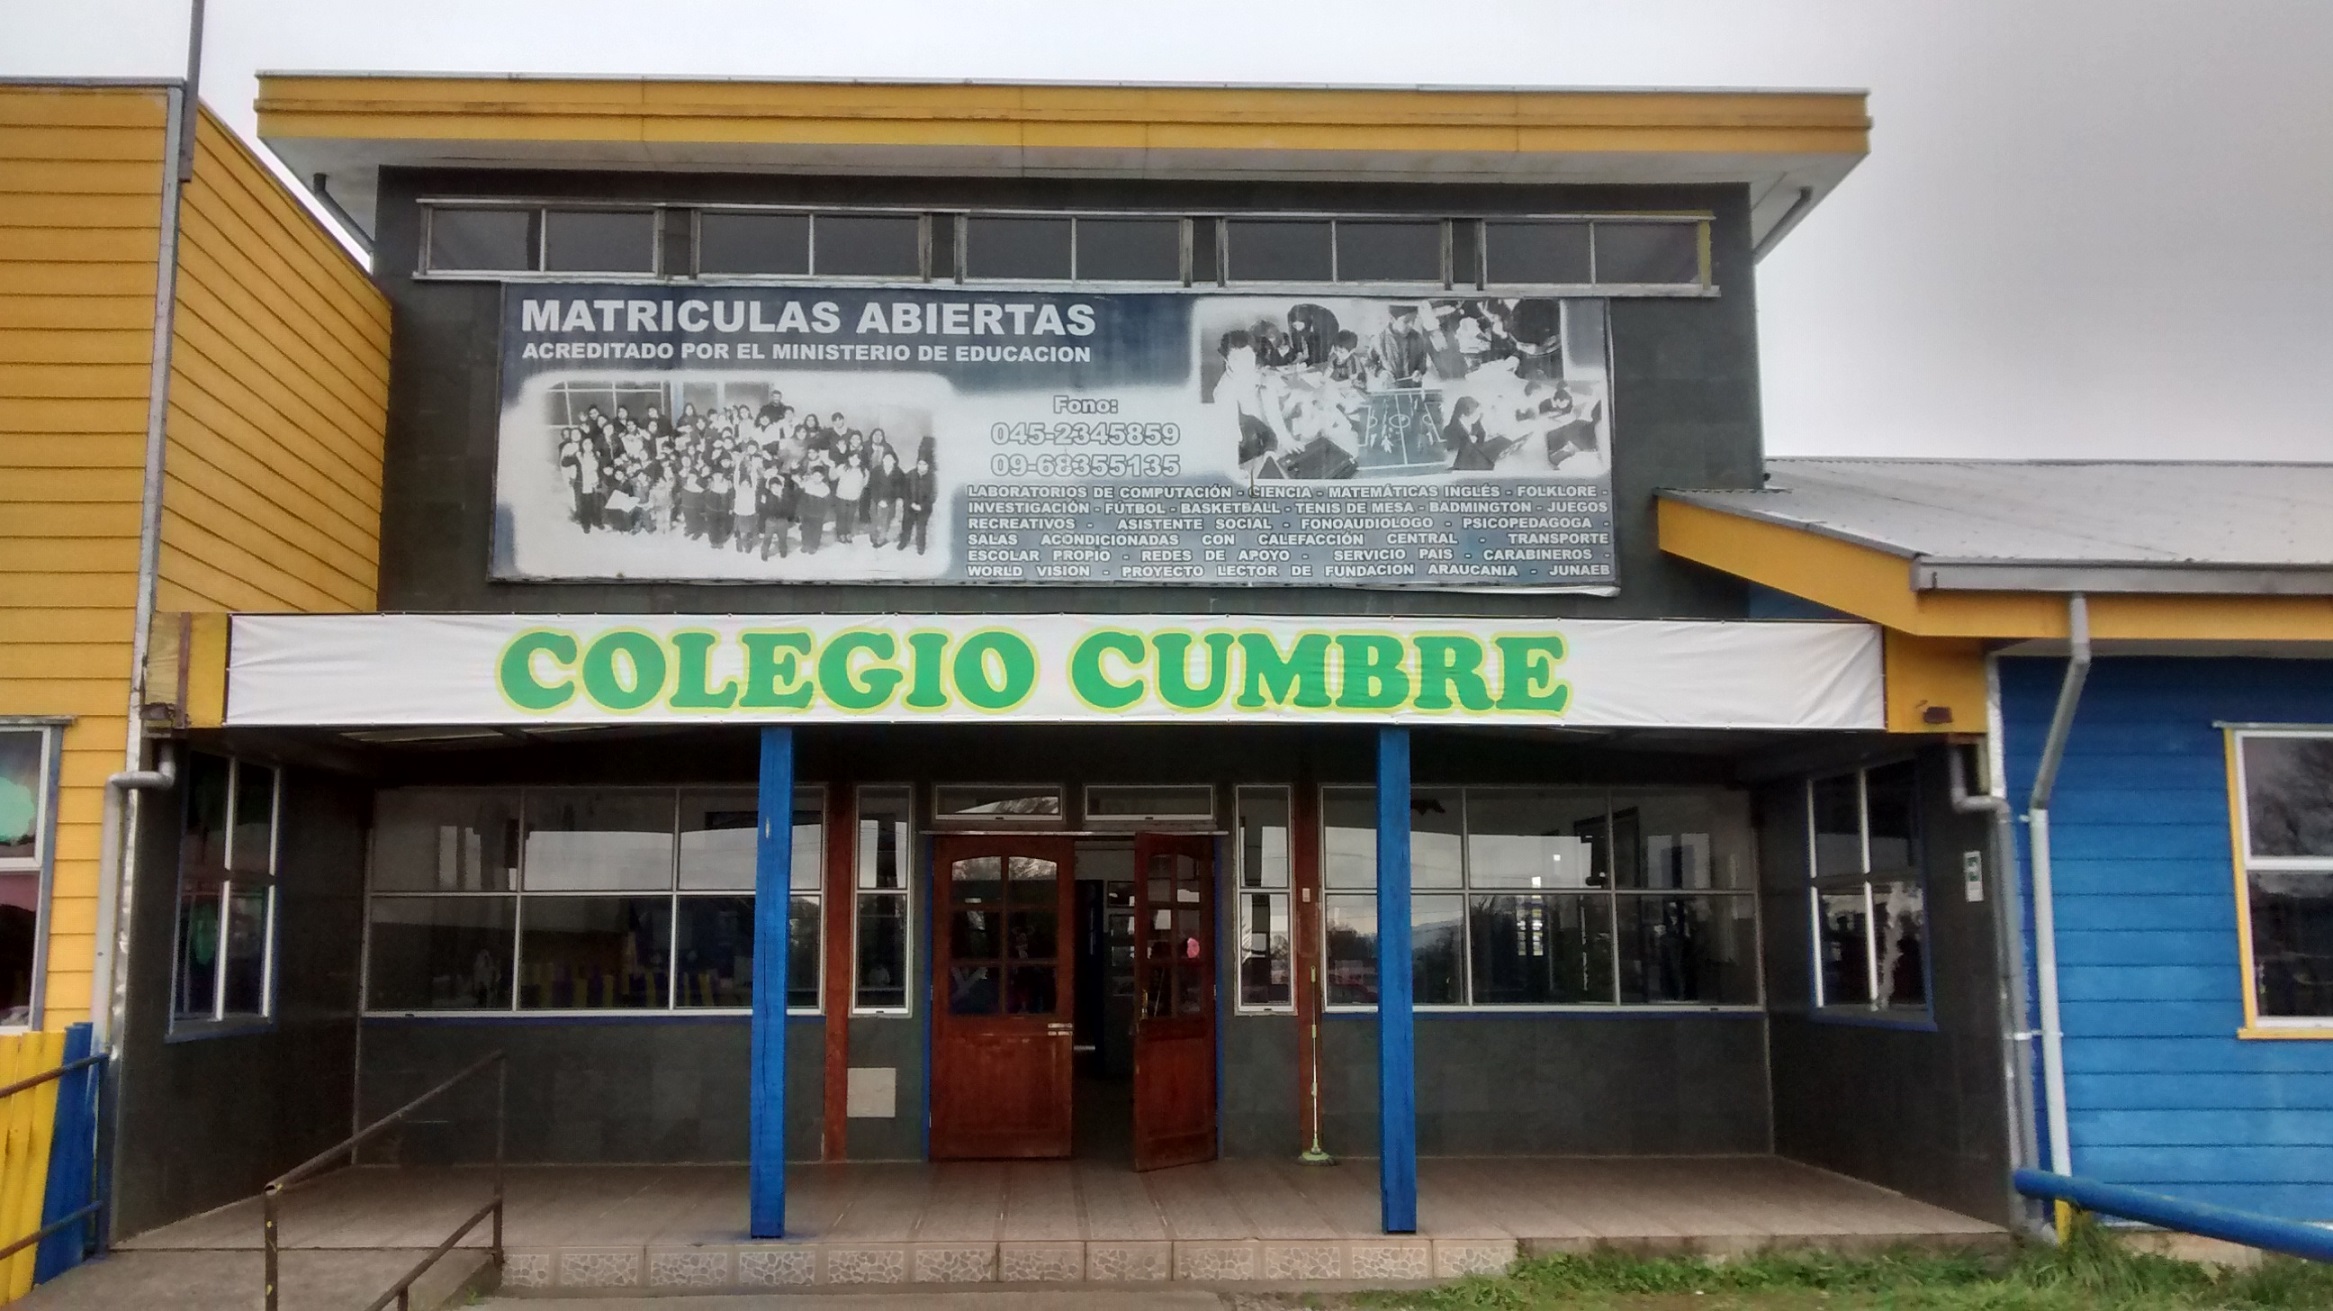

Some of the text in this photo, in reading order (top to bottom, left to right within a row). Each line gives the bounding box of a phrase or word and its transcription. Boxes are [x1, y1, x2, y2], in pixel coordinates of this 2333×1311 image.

[521, 299, 1096, 336] MATRICULAS ABIERTAS
[522, 342, 1092, 364] ACREDITADO POR EL MINISTERIO DE EDUCACION
[1053, 395, 1118, 414] Fono:
[990, 422, 1181, 446] 045-2345859
[990, 454, 1181, 477] 09-68355135
[967, 485, 1088, 498] LABORATORIOS
[1093, 486, 1114, 498] DE
[1119, 484, 1232, 498] COMPUTACIÓN
[1328, 484, 1438, 497] MATEMÁTICAS
[1444, 484, 1500, 497] INGLÉS
[1518, 486, 1597, 497] FOLKLORE
[967, 500, 1090, 514] INVESTIGACIÓN
[1180, 502, 1280, 514] BASKETBALL
[1296, 502, 1341, 514] TENIS
[1346, 503, 1367, 514] DE
[1371, 503, 1414, 513] MESA
[1429, 502, 1532, 513] BADMINGTON
[1547, 502, 1608, 513] JUEGOS
[967, 518, 1075, 530] RECREATIVOS
[1117, 518, 1203, 530] ASISTENTE
[1215, 519, 1272, 530] SOCIAL
[1301, 518, 1434, 528] FONOAUDIOLOGO
[1462, 517, 1592, 529] PSICOPEDAGOGA
[967, 534, 1018, 545] SALAS
[1041, 534, 1180, 546] ACONDICIONADAS
[1201, 534, 1236, 545] CON
[1257, 531, 1364, 546] CALEFACCIÓN
[1386, 534, 1458, 544] CENTRAL
[1508, 533, 1609, 544] TRANSPORTE
[967, 550, 1040, 562] ESCOLAR
[1052, 550, 1111, 562] PROPIO
[1141, 551, 1192, 561] REDES
[1205, 550, 1225, 561] DE
[1238, 550, 1290, 561] APOYO
[1334, 550, 1406, 559] SERVICIO
[1483, 549, 1593, 561] CARABINEROS
[967, 565, 1023, 577] WORLD
[1036, 565, 1090, 577] VISION
[1122, 566, 1204, 577] PROYECTO
[1216, 566, 1279, 577] LECTOR
[1291, 566, 1312, 577] DE
[1325, 565, 1415, 577] FUNDACION
[1428, 564, 1518, 577] ARAUCANIA
[1549, 564, 1611, 576] JUNAEB
[496, 626, 1573, 717] COLEGIO CUMBRE
